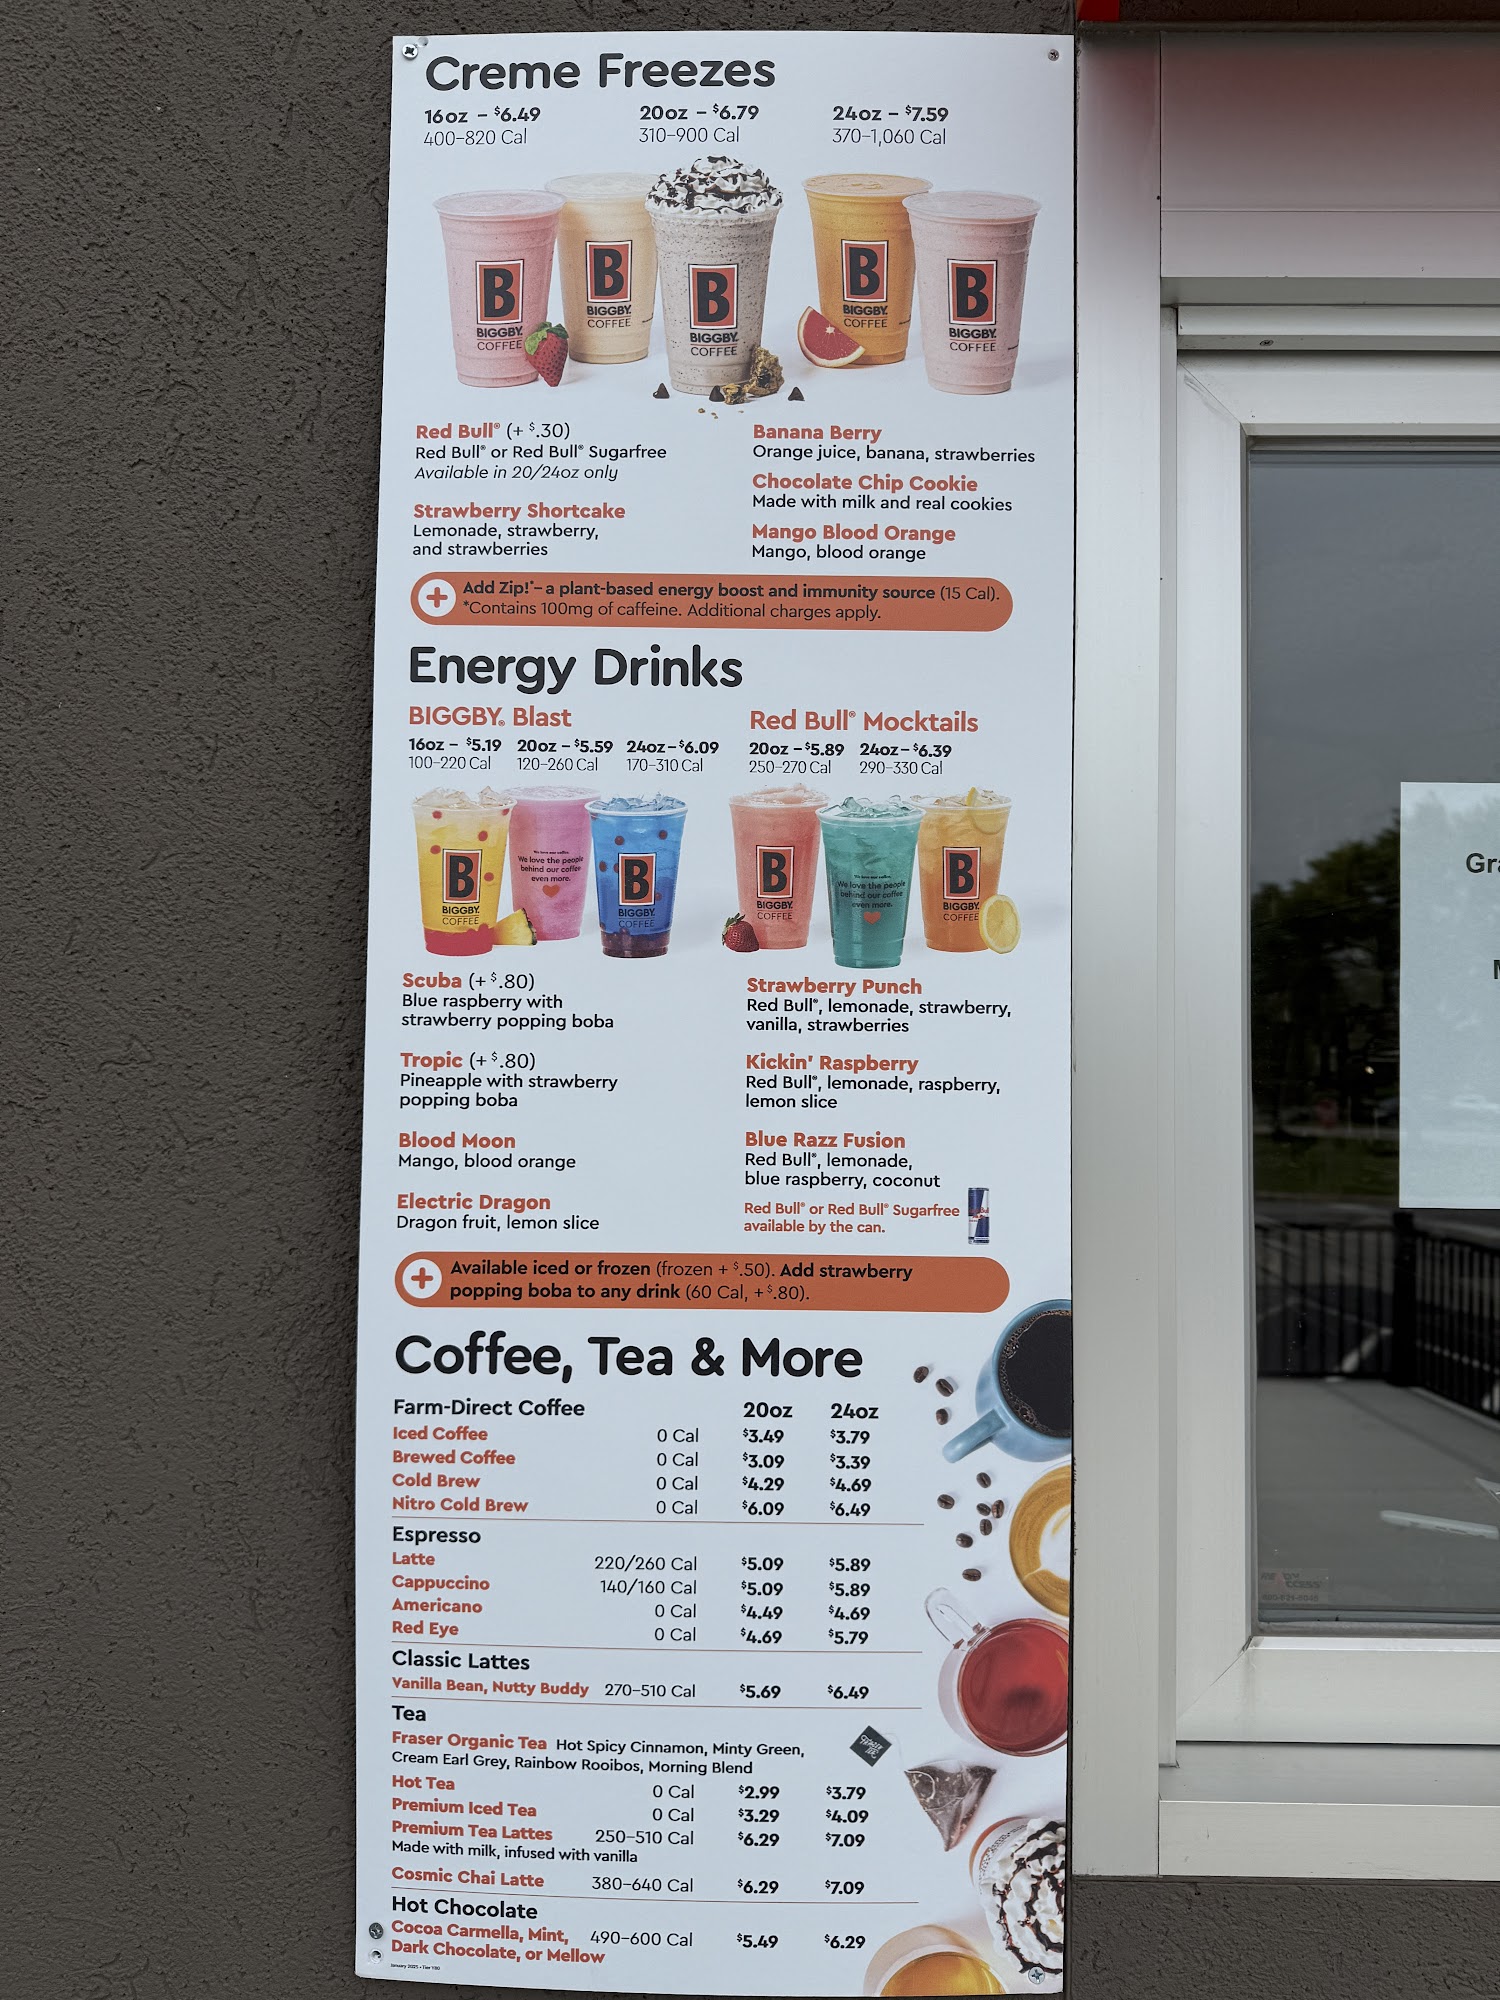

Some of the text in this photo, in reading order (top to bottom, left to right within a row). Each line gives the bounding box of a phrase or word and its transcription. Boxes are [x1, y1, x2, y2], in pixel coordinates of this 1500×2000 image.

[426, 53, 775, 91] Creme Freezes
[424, 109, 468, 124] 16oz
[494, 105, 541, 122] $6.49
[501, 127, 527, 145] Cal
[713, 126, 739, 143] Cal
[697, 272, 729, 322] B
[956, 267, 988, 318] B
[690, 346, 738, 357] COFFEE
[949, 341, 996, 352] COFFEE
[753, 424, 882, 444] Banana Berry
[753, 444, 1035, 463] Orange juice, banana, strawberries
[414, 464, 618, 482] Available in 20/24oz only
[752, 472, 978, 494] Chocolate Chip Cookie
[753, 493, 1012, 511] Made with milk and real cookies
[413, 502, 625, 522] Strawberry Shortcake
[752, 523, 956, 545] Mango Blood Orange
[541, 601, 593, 618] 100mg
[598, 601, 614, 615] of
[617, 601, 682, 616] caffeine.
[687, 602, 765, 617] Additional
[770, 603, 831, 621] charges
[835, 604, 881, 622] apply.
[410, 644, 743, 695] Energy Drinks
[751, 708, 797, 730] Red
[864, 710, 979, 732] Mocktails
[520, 864, 544, 873] behind
[560, 864, 582, 873] coffee
[529, 856, 545, 864] love
[547, 856, 560, 864] the
[562, 855, 584, 865] people
[1466, 852, 1500, 874] Gr
[402, 972, 462, 988] Scuba
[747, 976, 922, 997] Strawberry Punch
[402, 992, 563, 1011] Blue raspberry with
[401, 1012, 614, 1031] strawberry popping boba
[820, 1054, 919, 1075] Raspberry
[399, 1131, 515, 1149] Blood Moon
[746, 1130, 905, 1148] Blue Razz Fusion
[399, 1152, 576, 1171] Mango, blood orange
[397, 1192, 550, 1214] Electric Dragon
[744, 1219, 885, 1235] available by the can.
[395, 1330, 863, 1384] Coffee, Tea & More
[394, 1397, 585, 1416] Farm-Direct Coffee
[743, 1402, 793, 1418] 20oz
[831, 1403, 879, 1419] 24oz
[393, 1425, 488, 1441] Iced Coffee
[742, 1428, 784, 1443] $3.49
[830, 1429, 870, 1444] $3.79
[393, 1526, 481, 1546] Espresso
[392, 1552, 435, 1566] Latte
[595, 1554, 697, 1572] 220/260 Cal
[741, 1556, 784, 1571] $5.09
[829, 1557, 871, 1572] $5.89
[392, 1575, 490, 1592] Cappuccino
[392, 1649, 530, 1670] Classic Lattes
[392, 1676, 589, 1698] Vanilla Bean, Nutty Buddy
[671, 1684, 695, 1698] Cal
[740, 1683, 781, 1699] $5.69
[827, 1684, 869, 1699] $6.49
[391, 1705, 426, 1722] Tea
[392, 1731, 547, 1750] Fraser Organic Tea
[556, 1739, 804, 1758] Hot Spicy Cinnamon, Minty Green,
[392, 1751, 753, 1776] Cream Earl Grey, Rainbow Rooibos, Morning Blend
[392, 1797, 537, 1817] Premium Iced Tea
[738, 1808, 780, 1823] $3.29
[825, 1809, 869, 1823] $4.09
[392, 1896, 538, 1919] Hot Chocolate
[667, 1932, 693, 1947] Cal
[736, 1933, 778, 1948] $5.49
[824, 1934, 866, 1949] $6.29
[391, 1939, 606, 1963] Dark Chocolate, or Mellow
